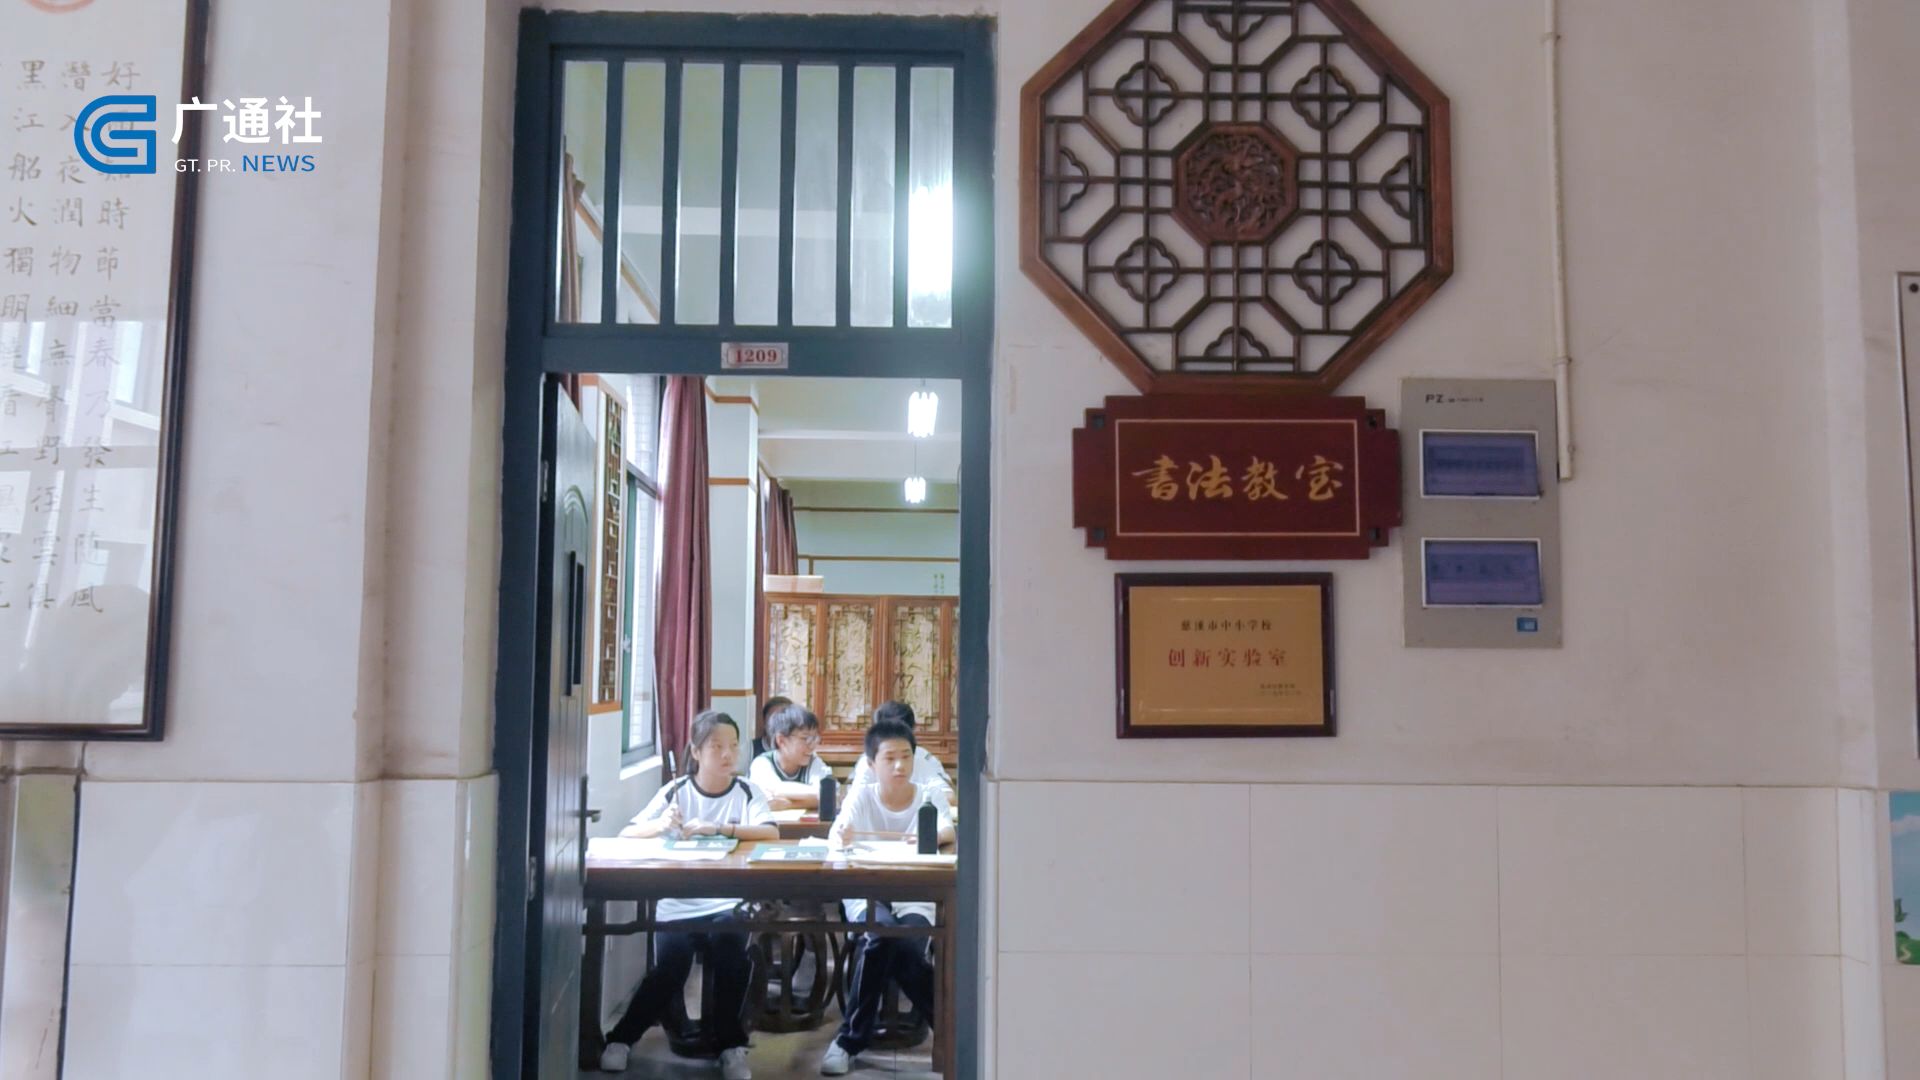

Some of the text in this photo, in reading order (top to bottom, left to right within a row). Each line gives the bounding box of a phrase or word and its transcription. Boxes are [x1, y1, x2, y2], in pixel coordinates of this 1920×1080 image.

[735, 349, 777, 363] 1209
[1169, 648, 1286, 667] 创新实验室
